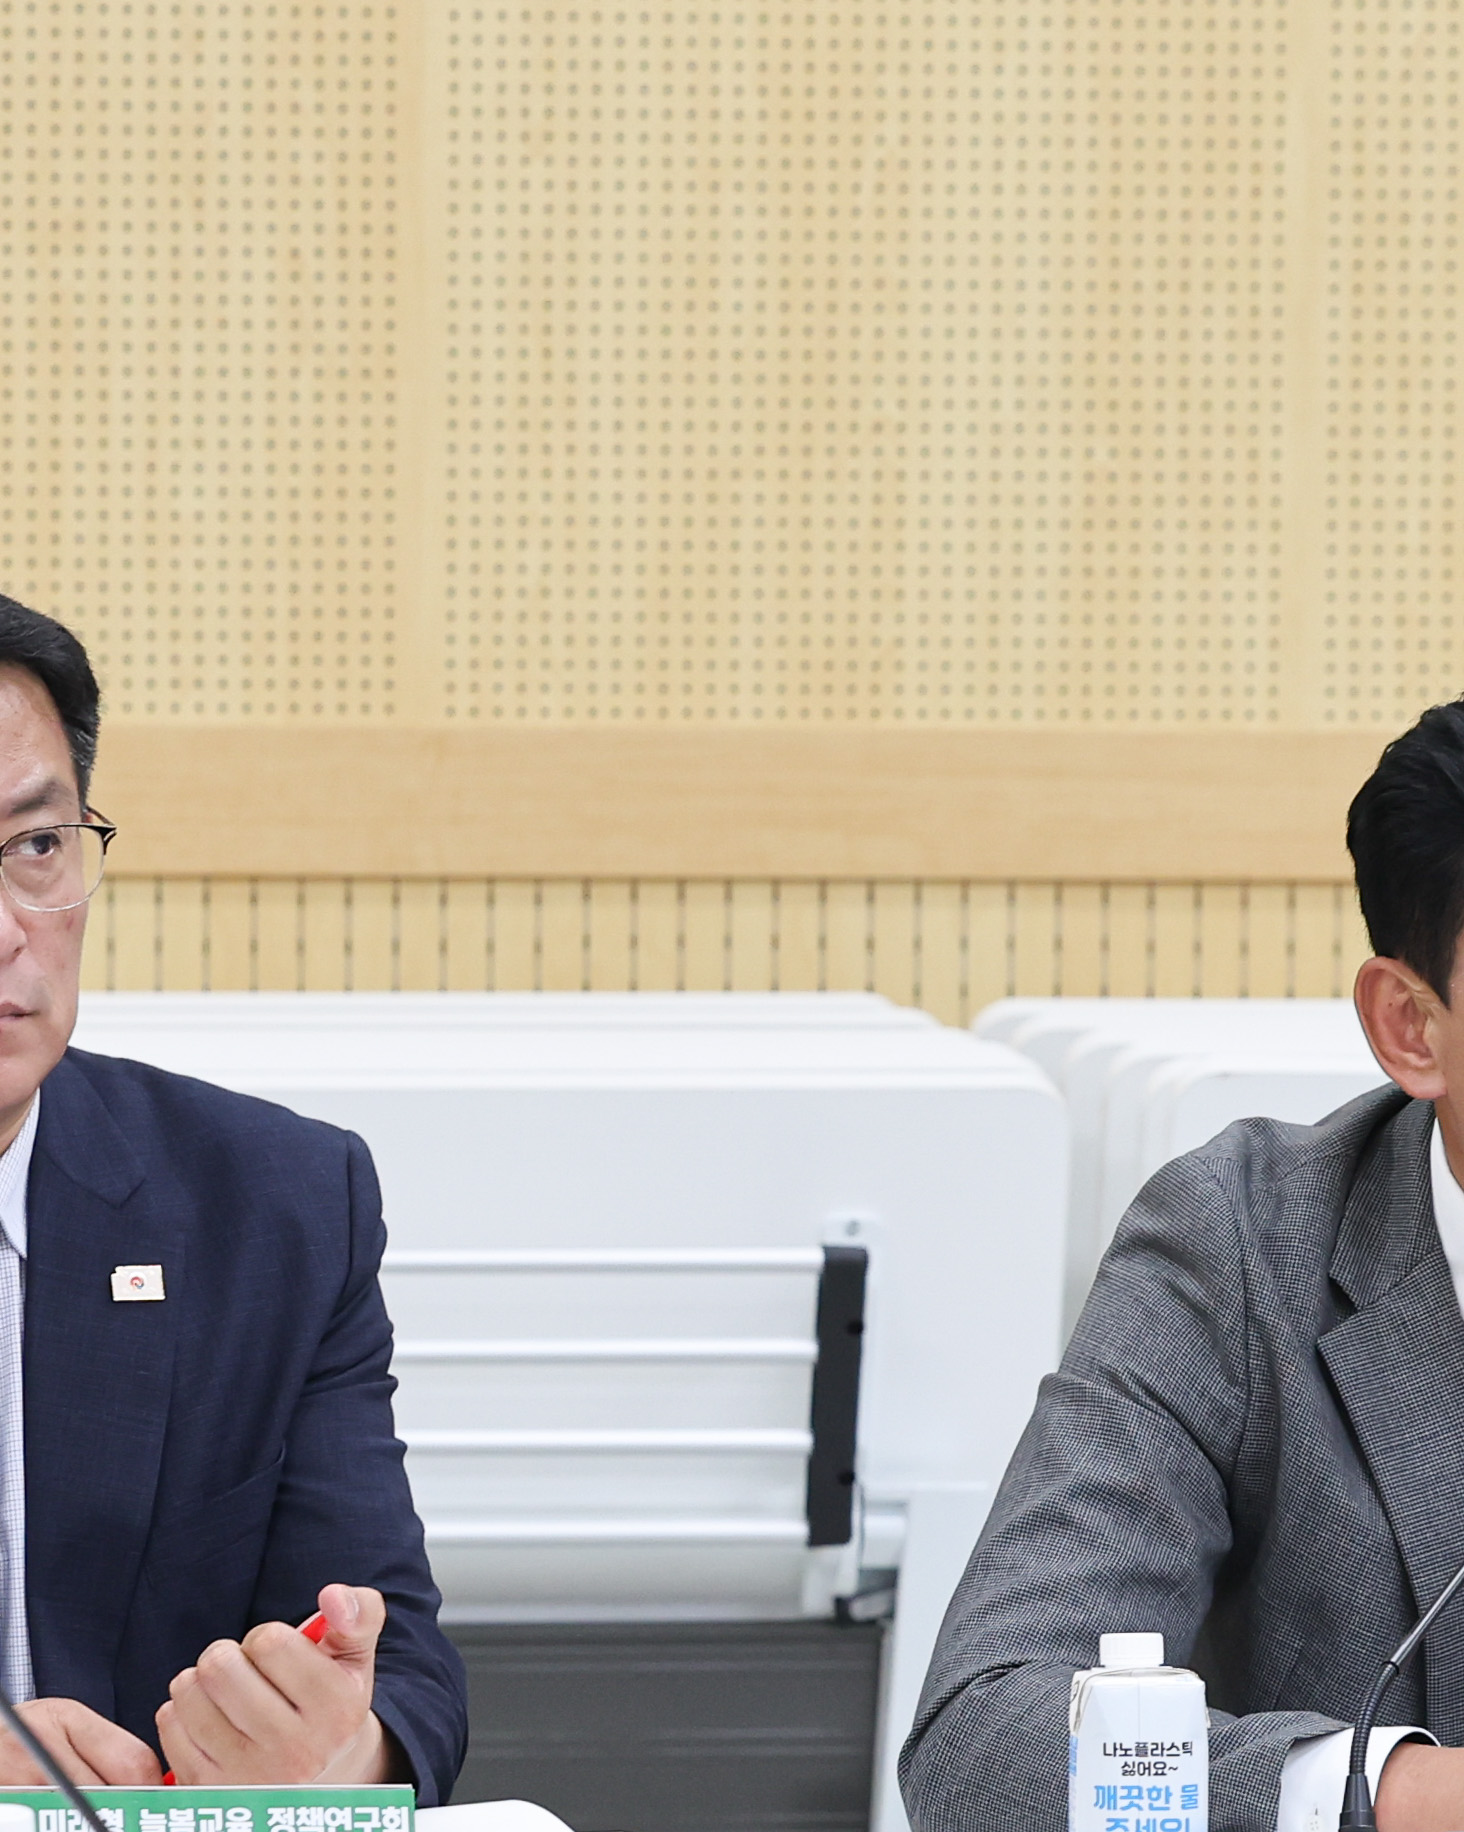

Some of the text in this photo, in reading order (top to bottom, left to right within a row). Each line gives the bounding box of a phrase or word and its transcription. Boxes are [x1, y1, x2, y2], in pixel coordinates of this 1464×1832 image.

[1102, 1741, 1193, 1758] 나노플라스틱
[1093, 1783, 1200, 1812] 깨끗한 물
